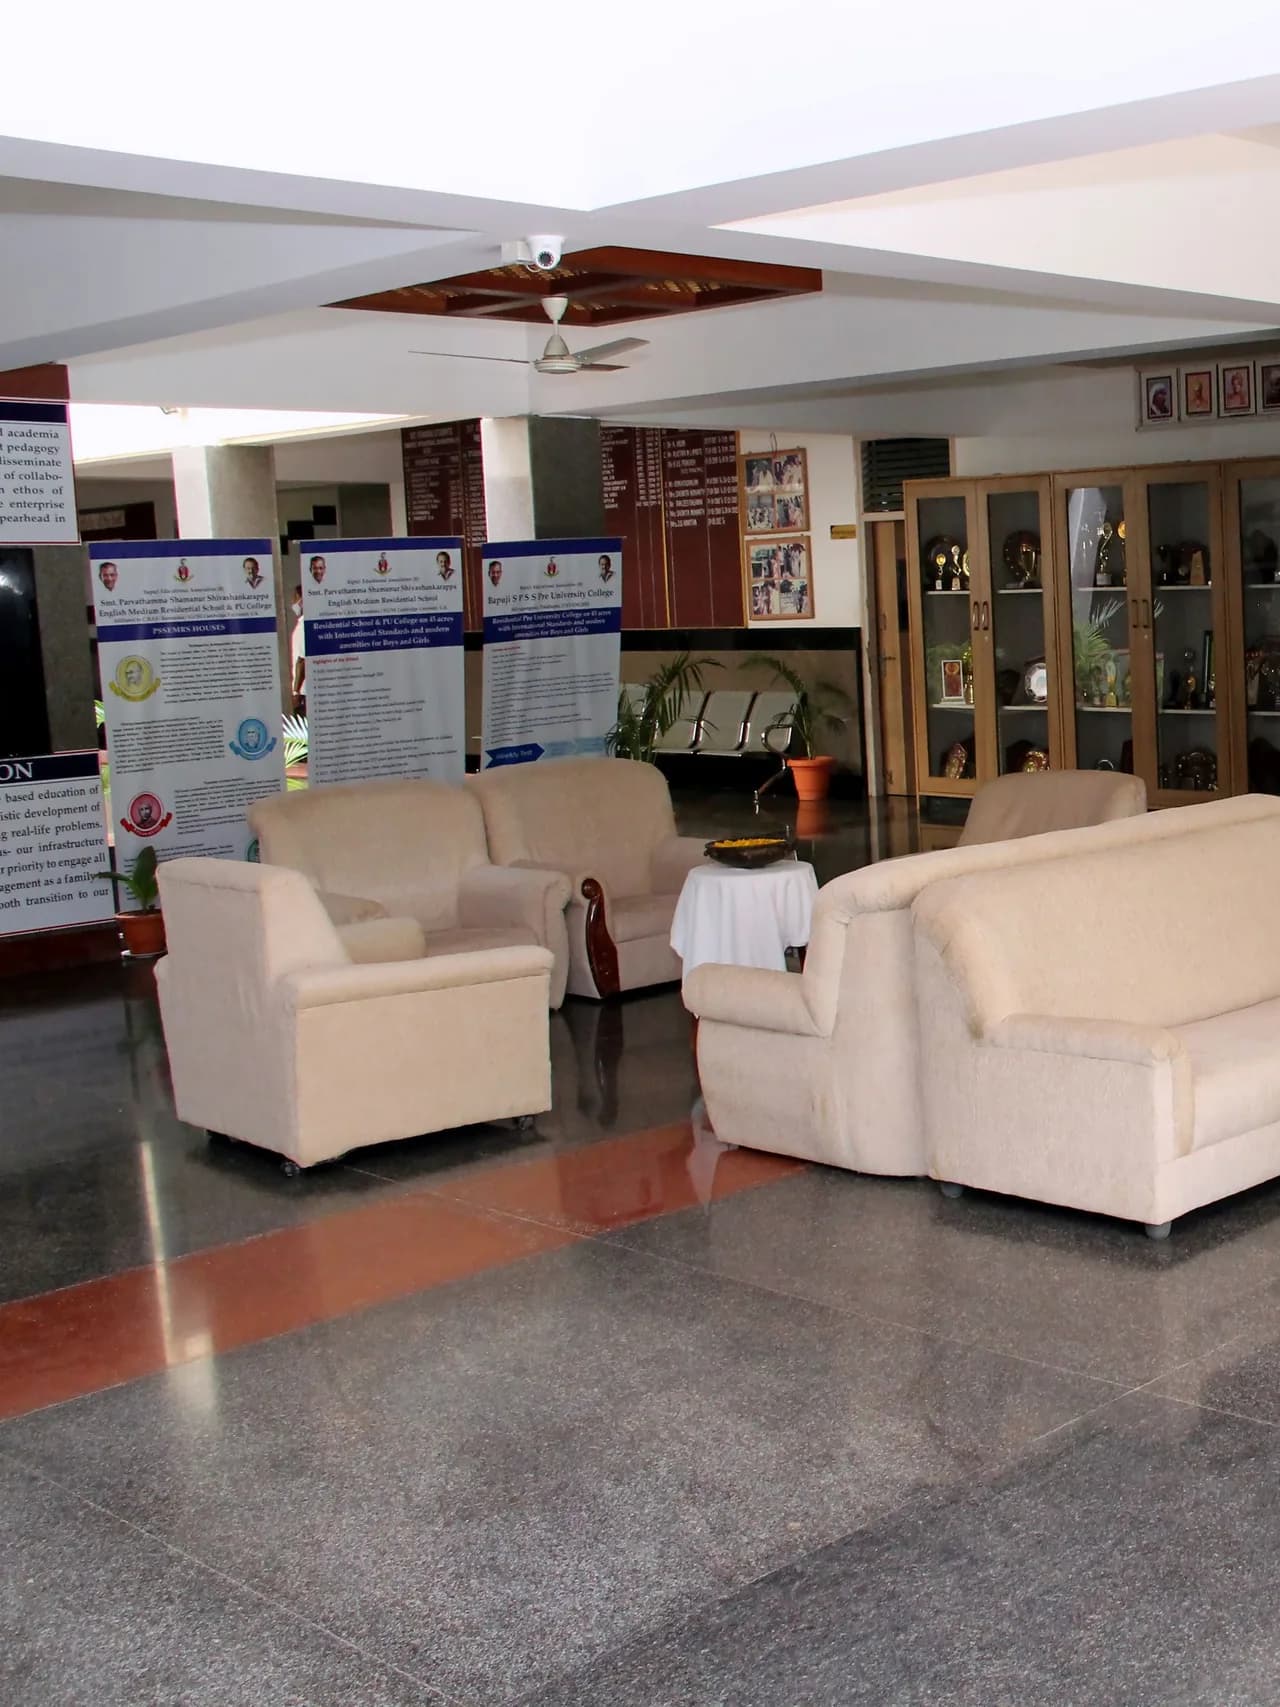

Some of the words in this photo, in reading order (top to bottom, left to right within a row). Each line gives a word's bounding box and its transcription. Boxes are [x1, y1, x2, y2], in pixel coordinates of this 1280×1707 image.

[7, 428, 59, 439] academia
[7, 443, 60, 455] pedagogy
[4, 472, 16, 480] of
[19, 472, 63, 481] collabo-
[13, 486, 44, 495] ethos
[52, 486, 64, 495] of
[9, 500, 64, 511] enterprise
[55, 514, 66, 522] in
[5, 792, 34, 803] based
[38, 786, 86, 800] education
[89, 784, 100, 794] of
[24, 804, 88, 818] development
[91, 802, 101, 812] of
[12, 825, 50, 838] real-life
[55, 820, 102, 835] problems.
[16, 846, 33, 855] our
[38, 838, 104, 852] infrastructure
[8, 862, 44, 876] priority
[47, 859, 56, 868] to
[58, 857, 93, 870] engage
[94, 853, 105, 863] all
[44, 878, 54, 886] as
[56, 877, 62, 885] a
[26, 892, 74, 906] transition
[79, 890, 88, 899] to
[93, 888, 109, 897] our
